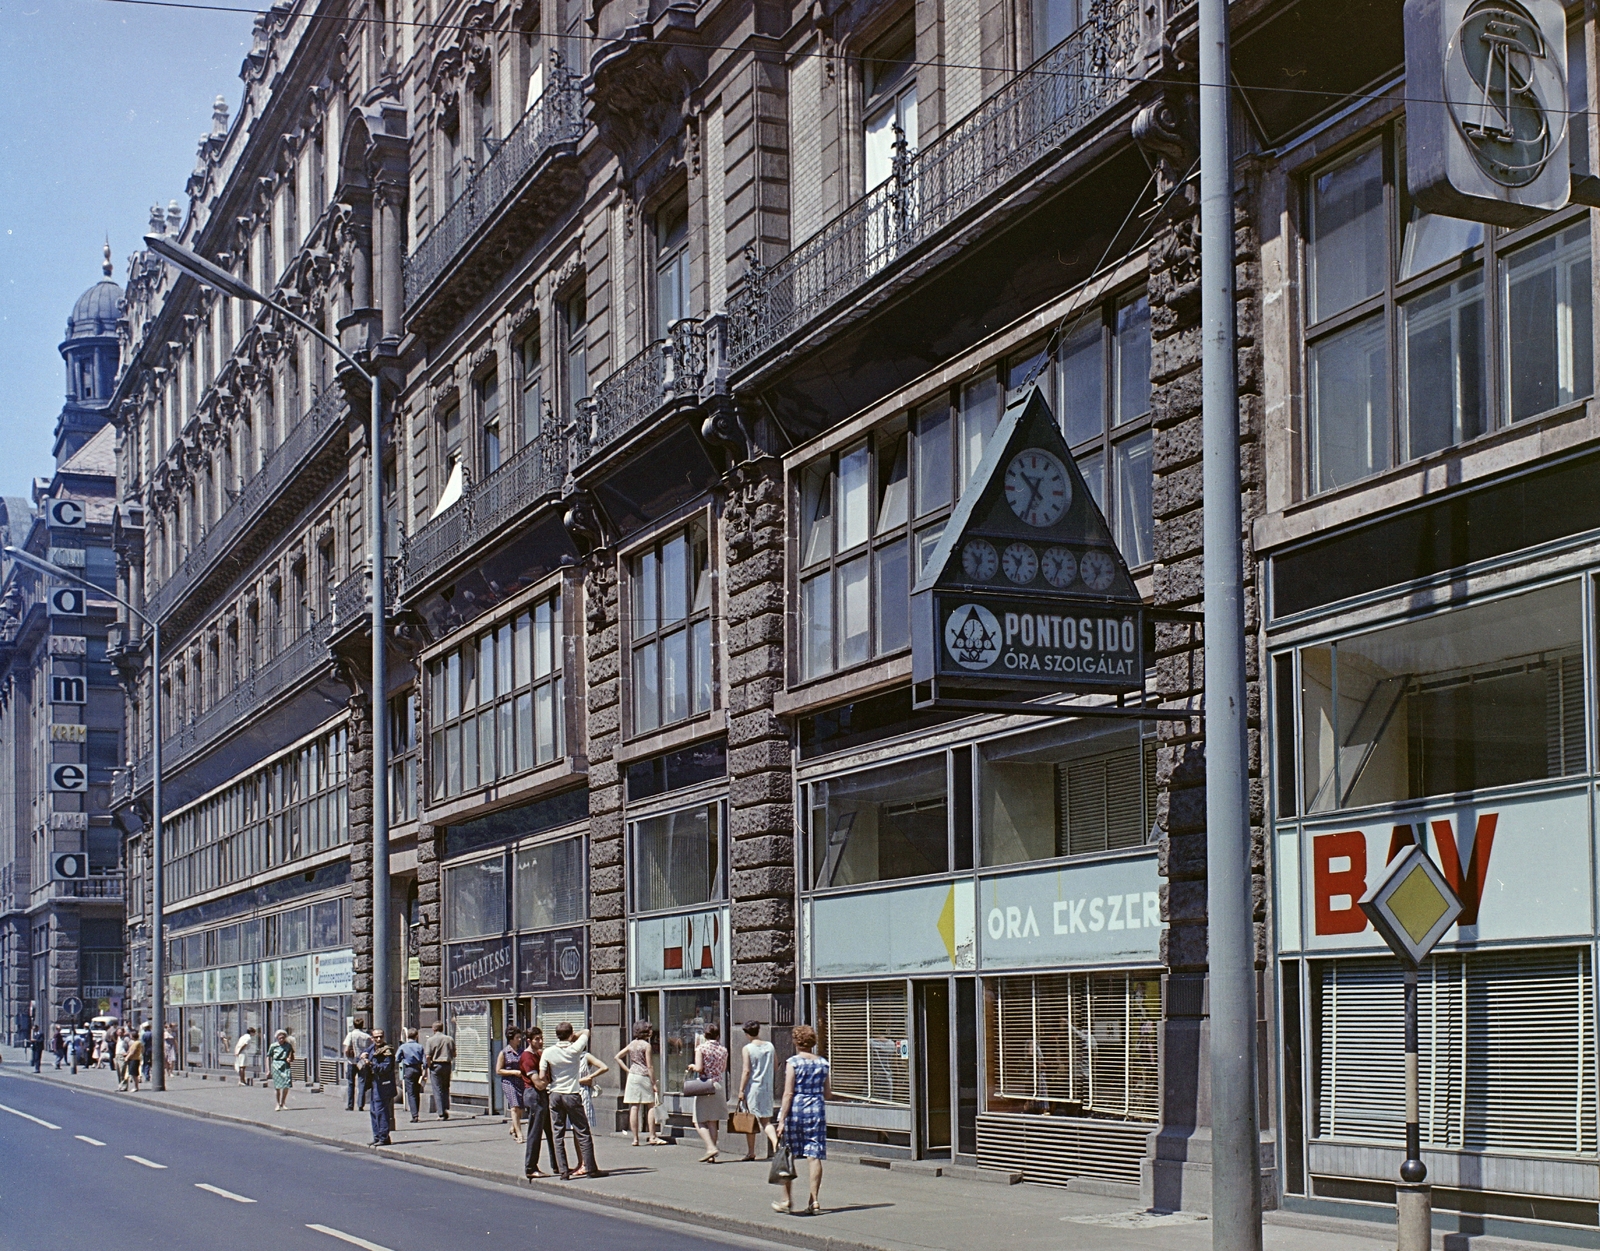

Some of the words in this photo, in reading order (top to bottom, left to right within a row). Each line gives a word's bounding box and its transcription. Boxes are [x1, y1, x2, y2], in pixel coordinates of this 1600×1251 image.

[1004, 612, 1093, 650] PONTOS
[1097, 615, 1135, 653] IDŐ
[1003, 647, 1041, 671] ÓRA
[1044, 653, 1134, 676] SZOLGÁLAT
